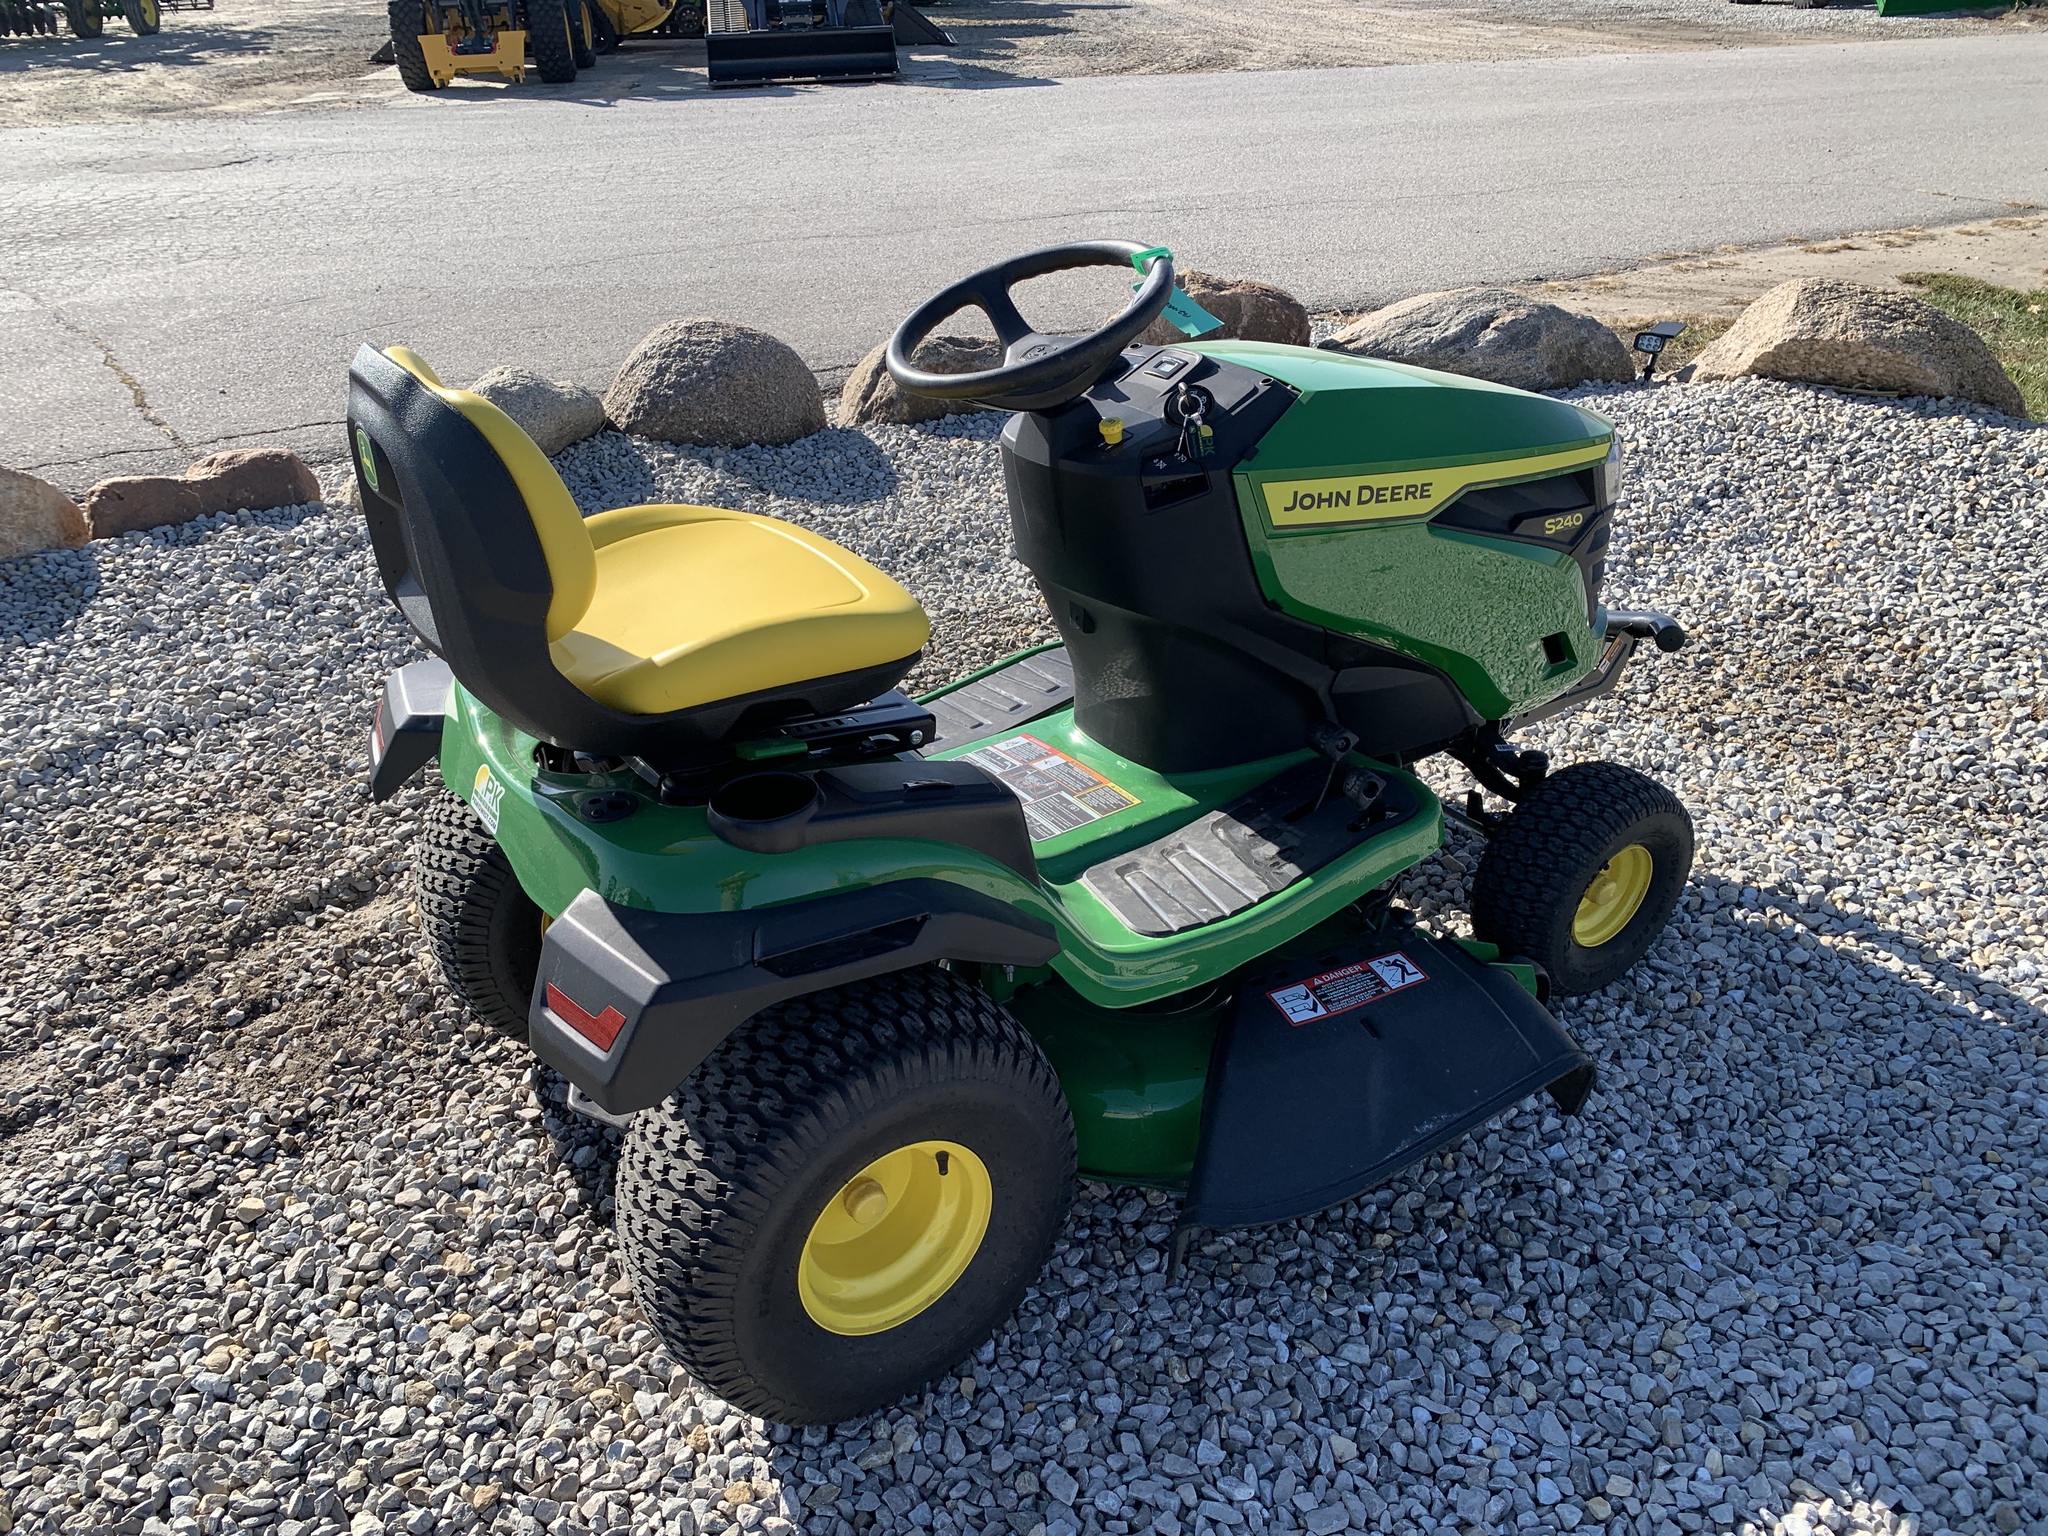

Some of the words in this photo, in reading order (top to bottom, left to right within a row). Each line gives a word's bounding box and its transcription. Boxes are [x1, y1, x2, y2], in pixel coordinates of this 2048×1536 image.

[1283, 490, 1351, 512] JOHN
[1357, 482, 1433, 506] DEERE
[1544, 512, 1583, 535] S240
[1321, 964, 1364, 982] DANGER
